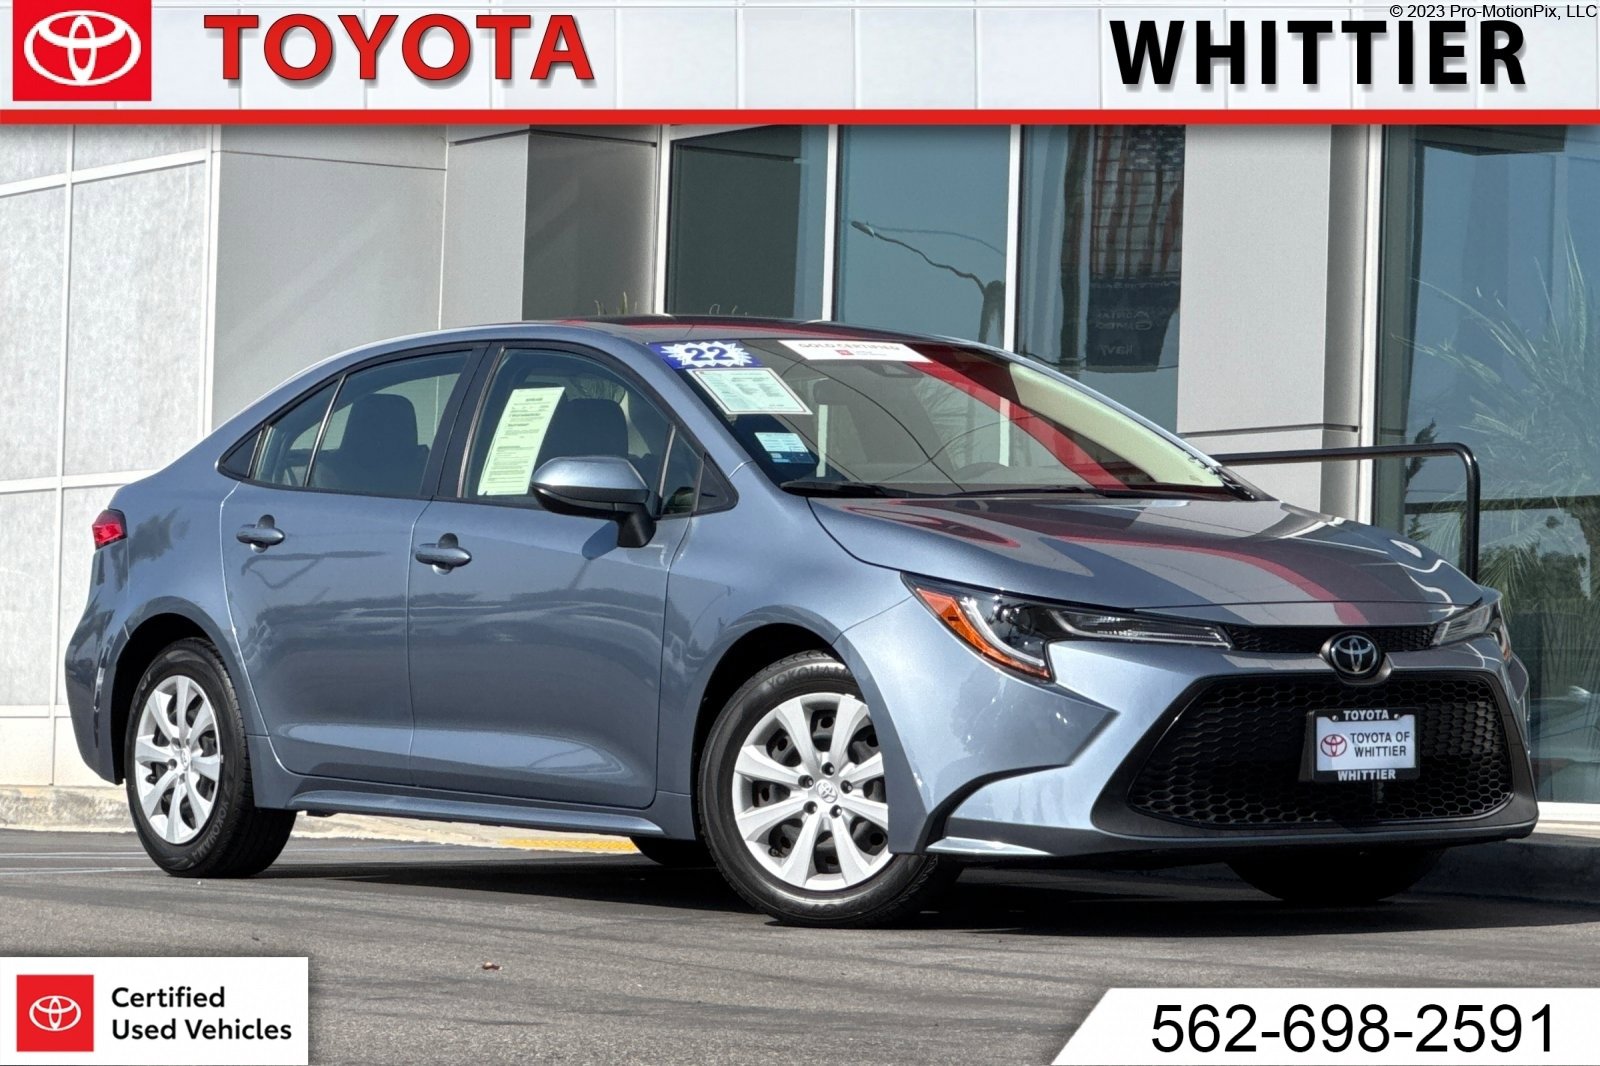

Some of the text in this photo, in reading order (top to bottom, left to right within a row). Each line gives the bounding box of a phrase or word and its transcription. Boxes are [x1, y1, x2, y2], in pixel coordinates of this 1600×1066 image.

[1343, 709, 1389, 720] TOYOTA
[1350, 731, 1410, 744] TOYOTA OF
[1354, 745, 1407, 758] WHITTIER
[1337, 769, 1396, 781] WHITTIER
